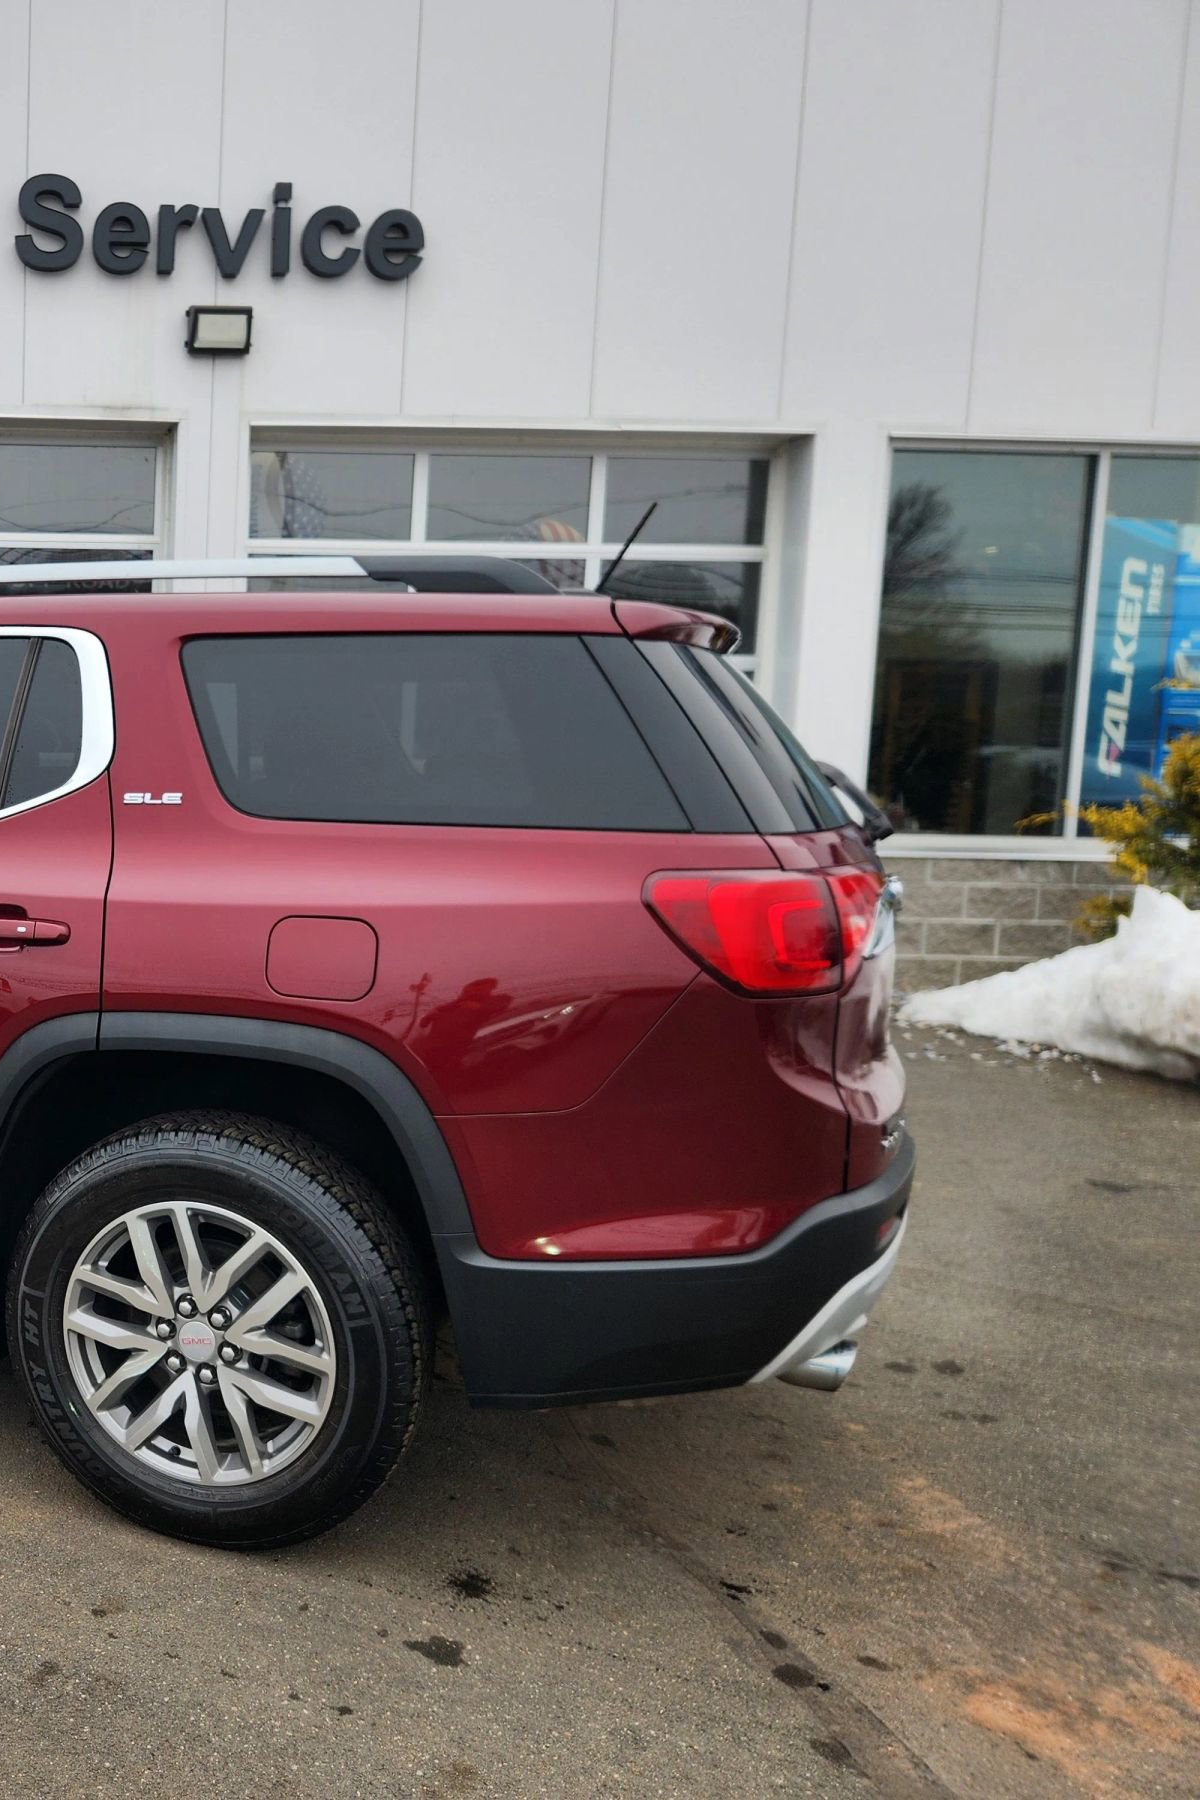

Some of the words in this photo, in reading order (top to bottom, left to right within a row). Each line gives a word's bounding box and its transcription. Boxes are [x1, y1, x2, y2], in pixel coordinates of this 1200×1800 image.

[15, 173, 425, 281] Service
[1097, 556, 1148, 778] FALKEN
[123, 792, 183, 804] SLE
[182, 1337, 212, 1345] GMC
